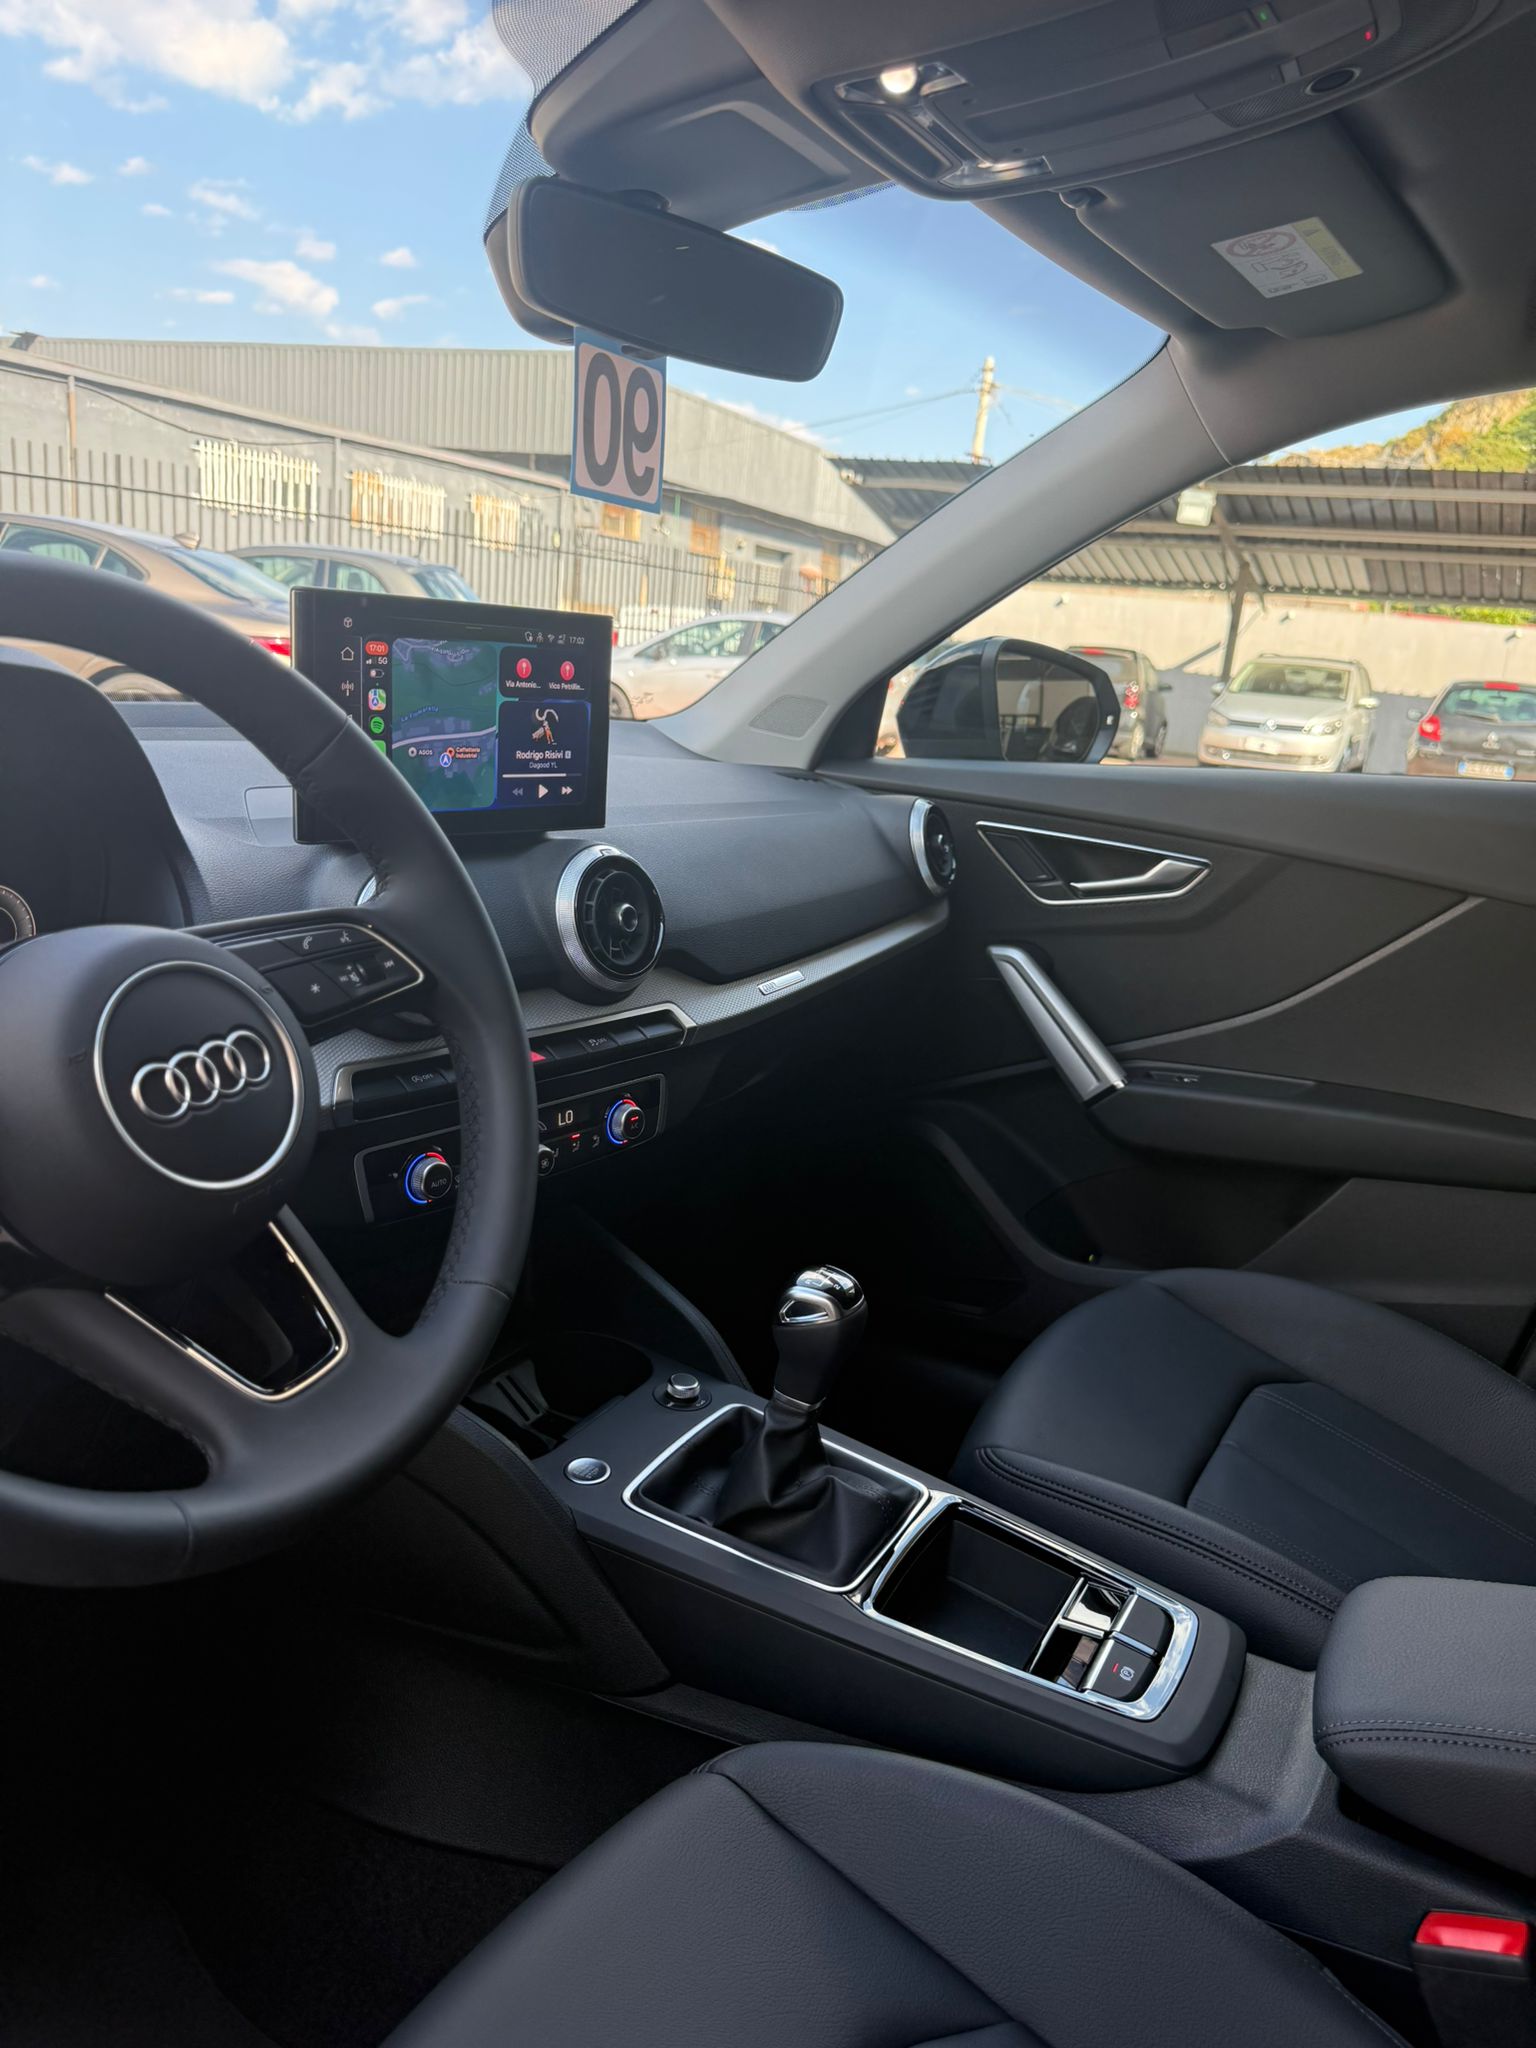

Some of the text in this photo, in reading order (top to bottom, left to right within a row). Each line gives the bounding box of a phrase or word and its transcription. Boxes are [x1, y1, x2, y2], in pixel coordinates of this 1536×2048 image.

[569, 636, 585, 645] 17:02
[369, 644, 386, 653] 17:01
[377, 656, 388, 665] 5G
[505, 680, 515, 688] Via
[516, 750, 544, 761] Rodrigo
[558, 1109, 574, 1126] LO
[431, 1178, 447, 1188] AUTO
